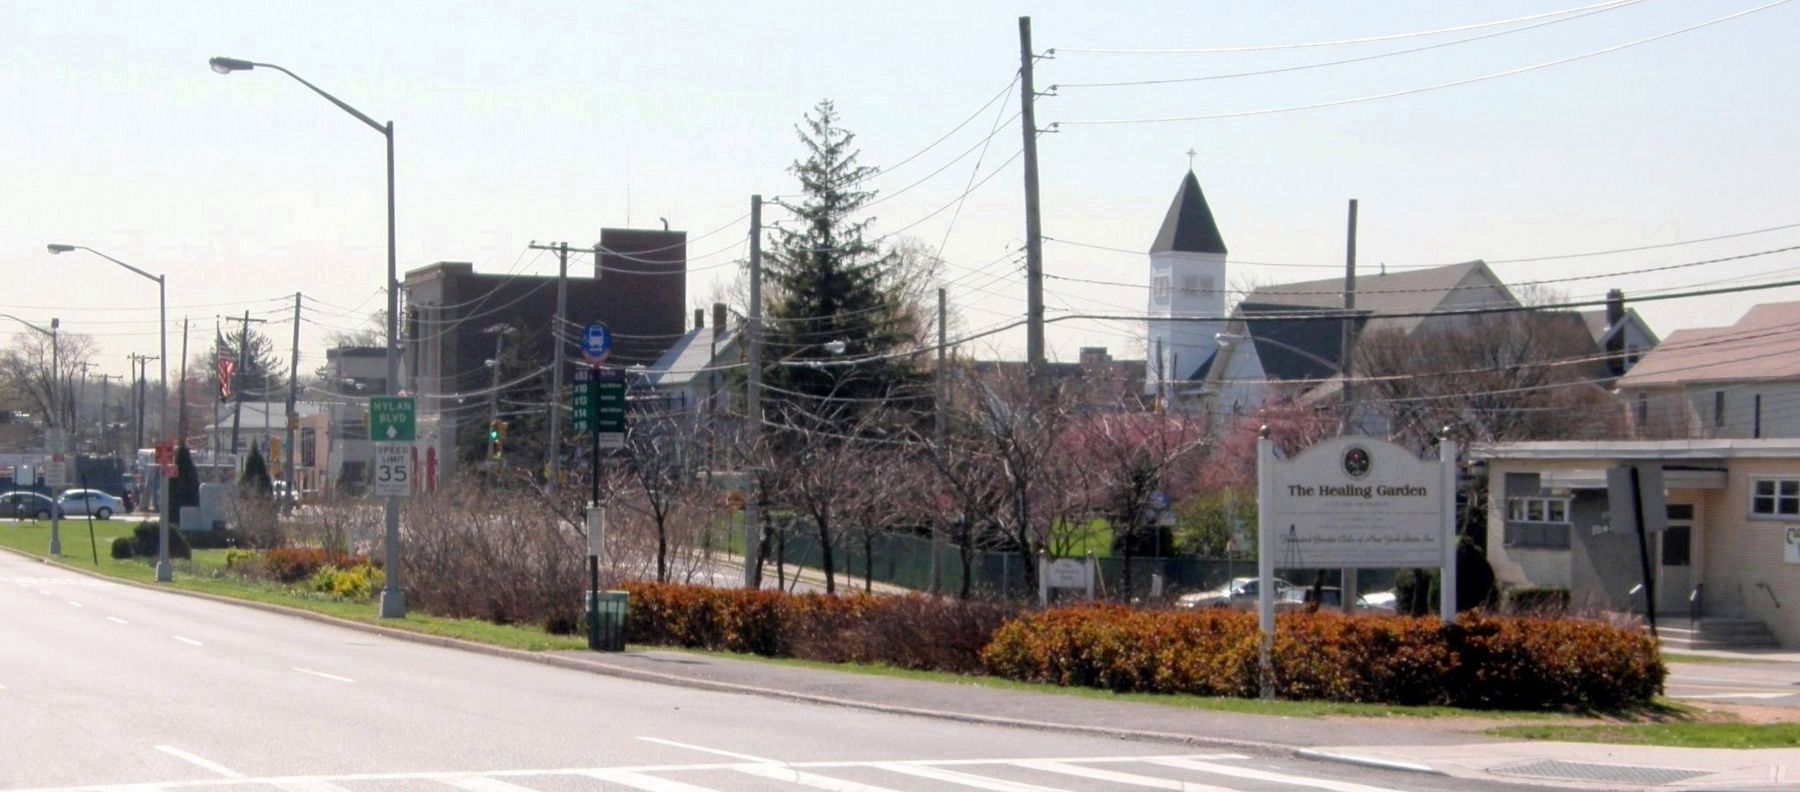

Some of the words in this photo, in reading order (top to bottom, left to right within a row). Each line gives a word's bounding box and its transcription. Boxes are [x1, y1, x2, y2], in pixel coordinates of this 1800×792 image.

[373, 400, 412, 411] HYLAN
[379, 412, 406, 423] BLVD
[378, 445, 409, 454] SPEED
[382, 455, 405, 463] LIMIT
[378, 464, 407, 482] 35
[1288, 484, 1315, 497] The
[1318, 484, 1372, 499] Healing
[1376, 484, 1427, 497] Garden
